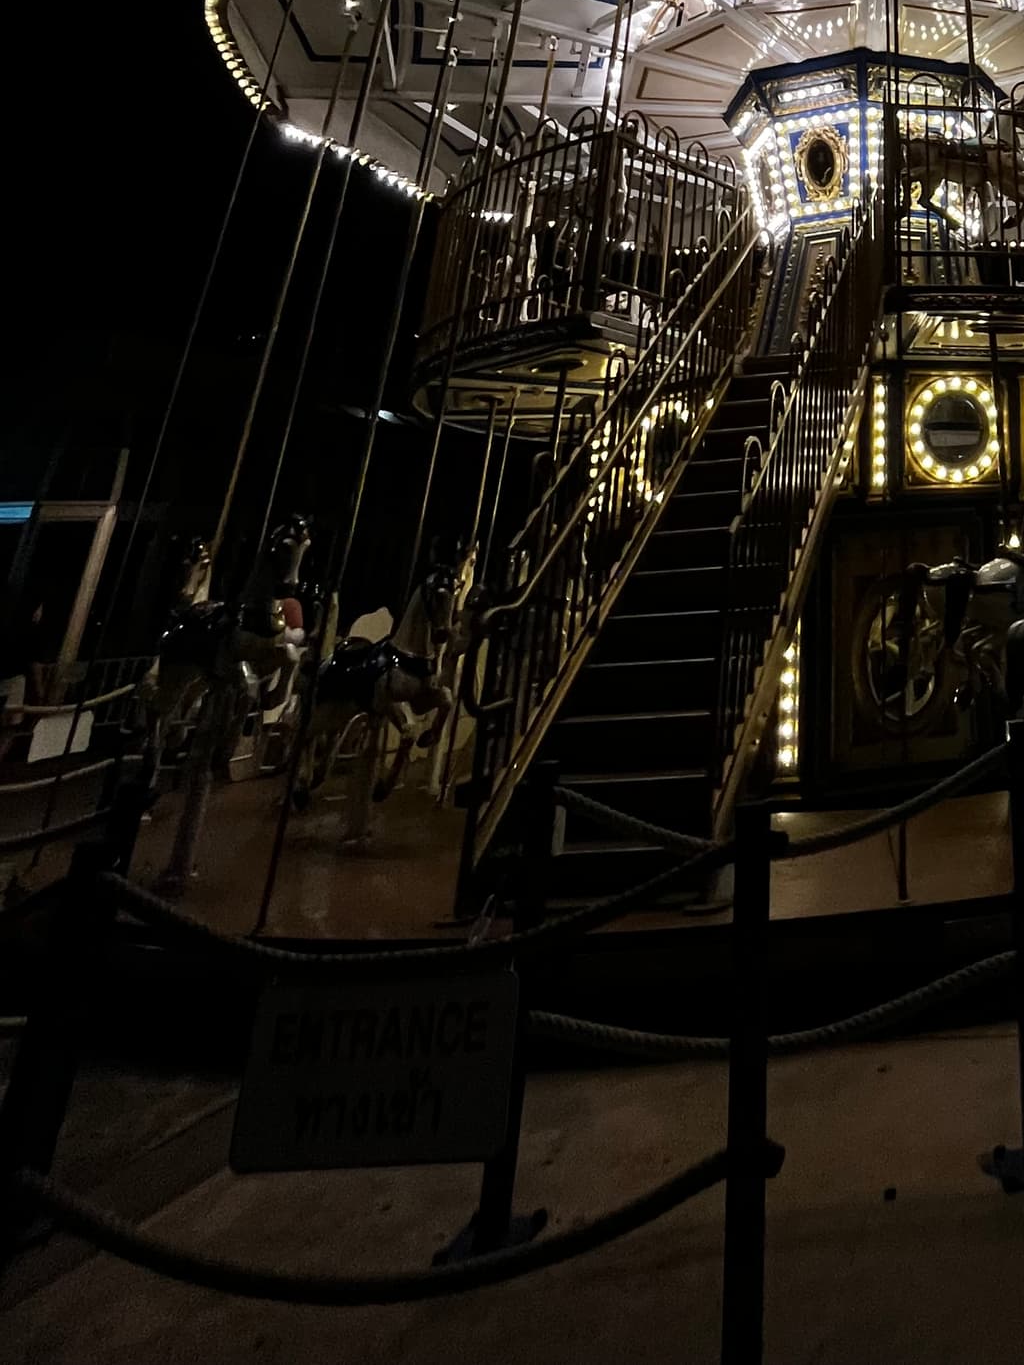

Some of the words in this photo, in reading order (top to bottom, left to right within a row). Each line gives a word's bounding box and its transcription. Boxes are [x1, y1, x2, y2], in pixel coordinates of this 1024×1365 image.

[269, 999, 490, 1066] ENTRANCE
[293, 1066, 442, 1145] ทางเข้า
